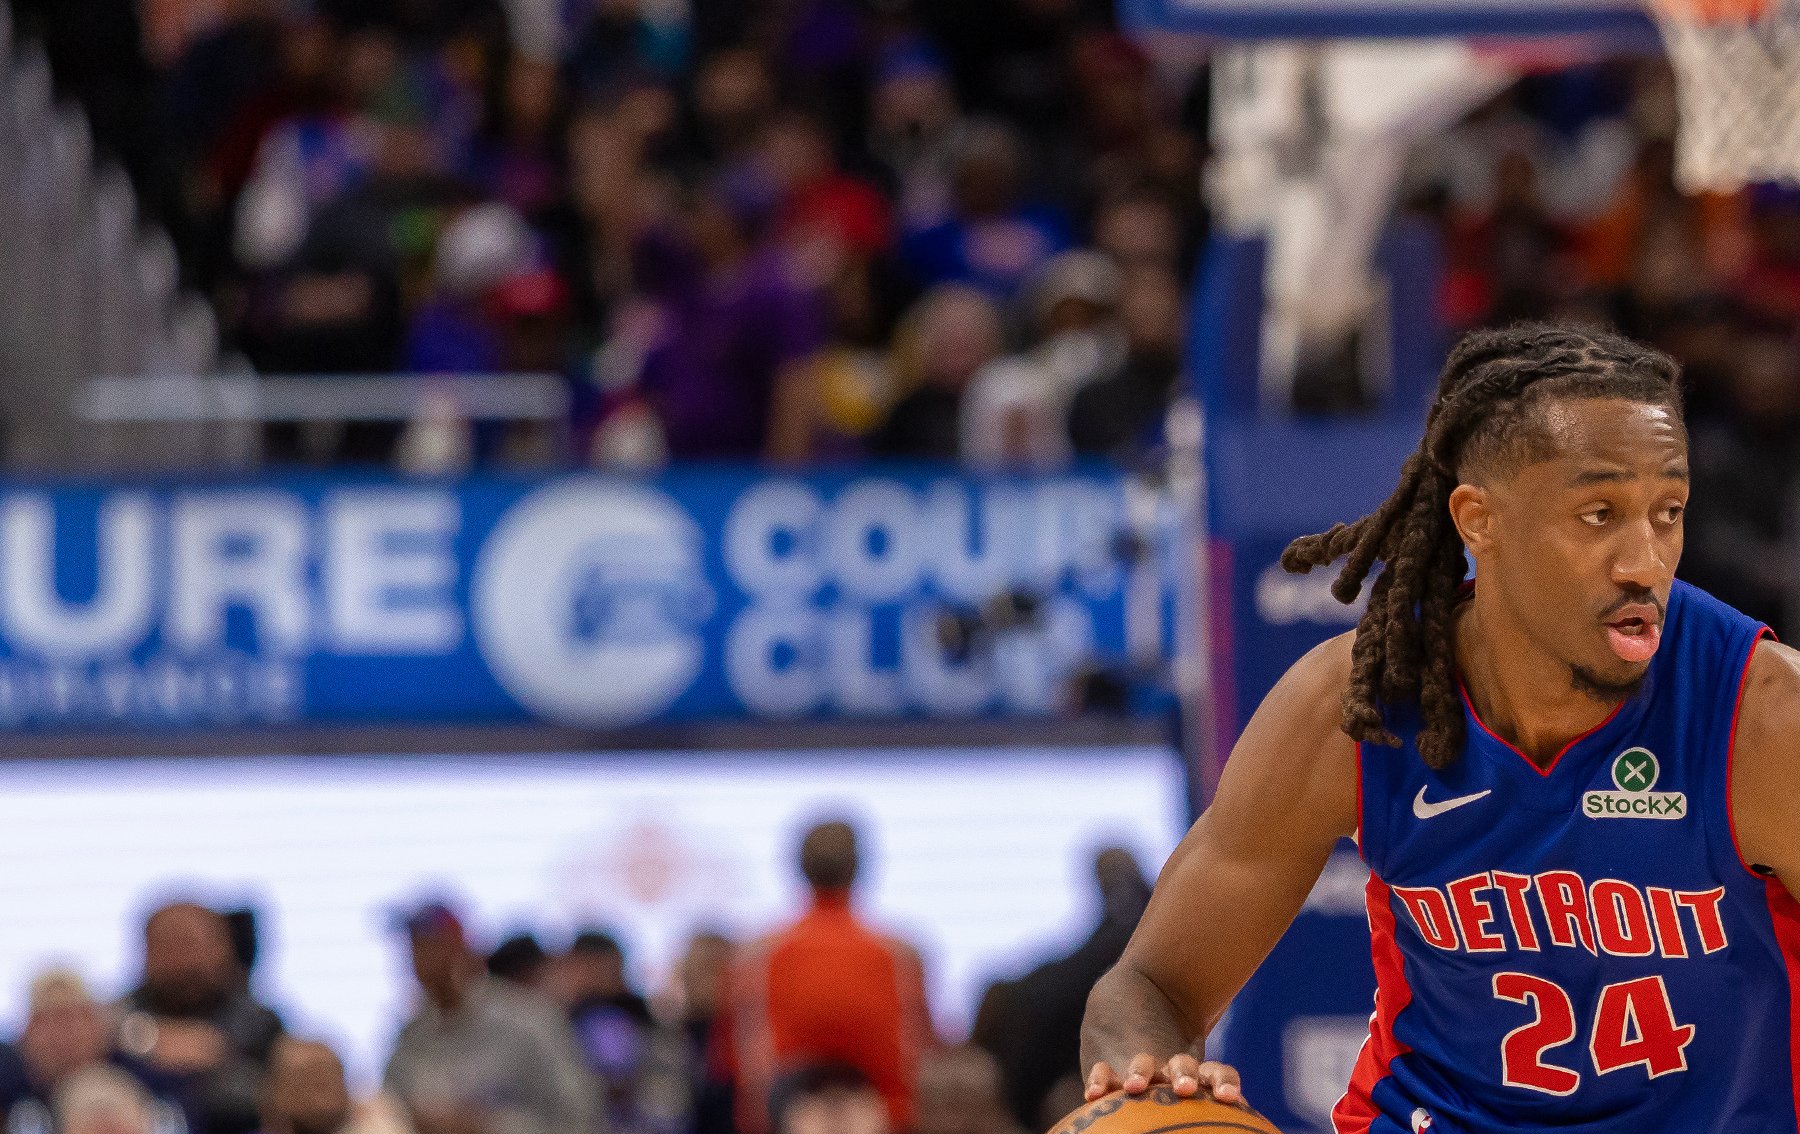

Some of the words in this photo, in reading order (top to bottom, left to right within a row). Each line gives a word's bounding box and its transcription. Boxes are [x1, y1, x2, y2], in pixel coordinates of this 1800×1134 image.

[1586, 794, 1683, 815] StockX
[1391, 870, 1729, 959] DETROIT
[1492, 971, 1696, 1097] 24
